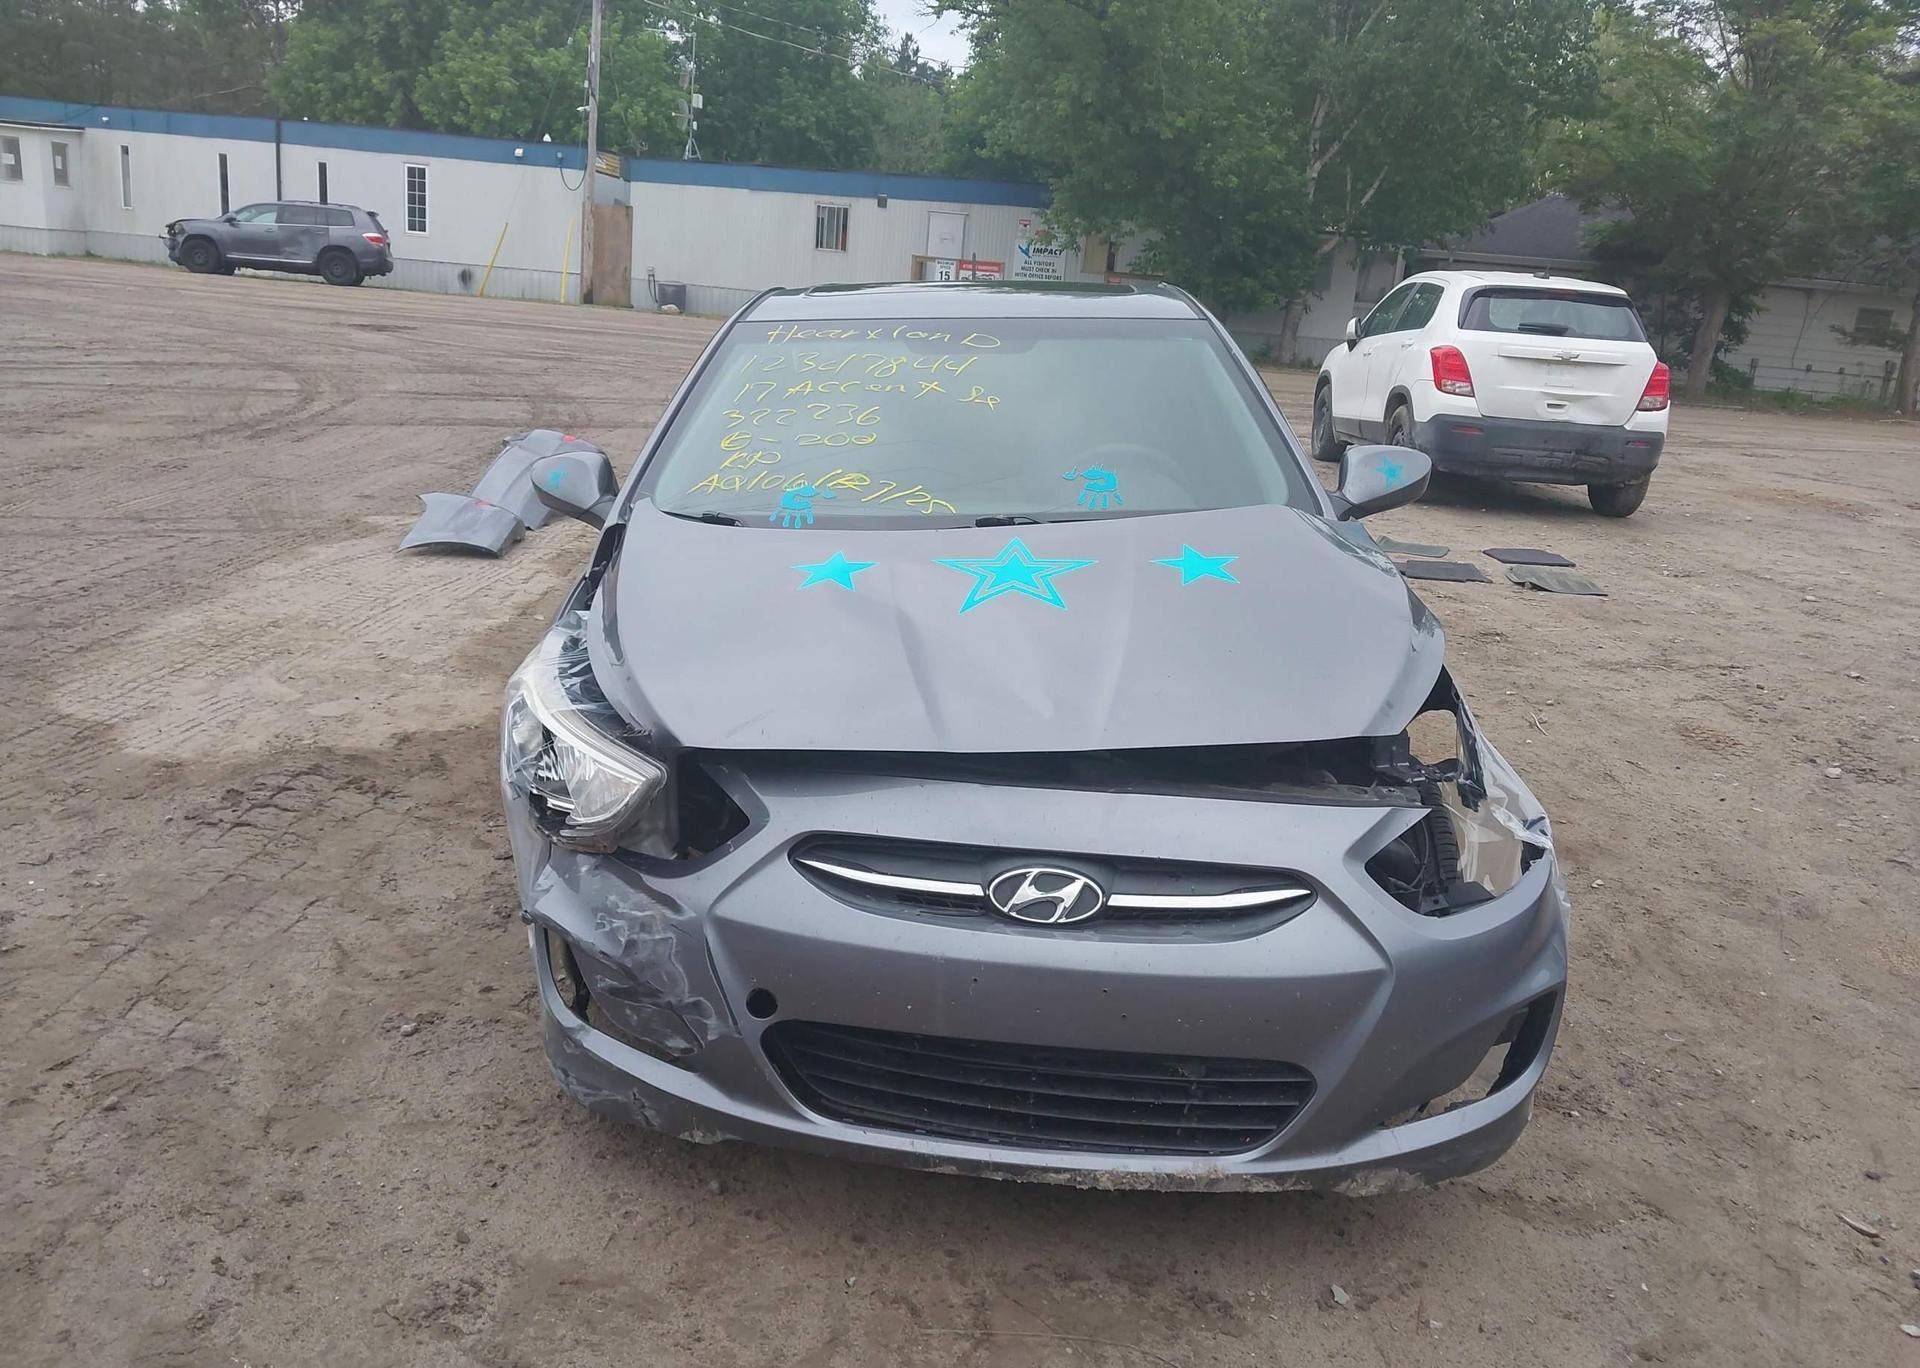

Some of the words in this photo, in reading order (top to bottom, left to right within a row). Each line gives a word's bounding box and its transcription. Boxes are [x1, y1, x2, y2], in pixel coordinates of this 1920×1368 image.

[1032, 247, 1064, 256] IMPACT
[938, 270, 951, 280] 15
[734, 381, 777, 405] 17
